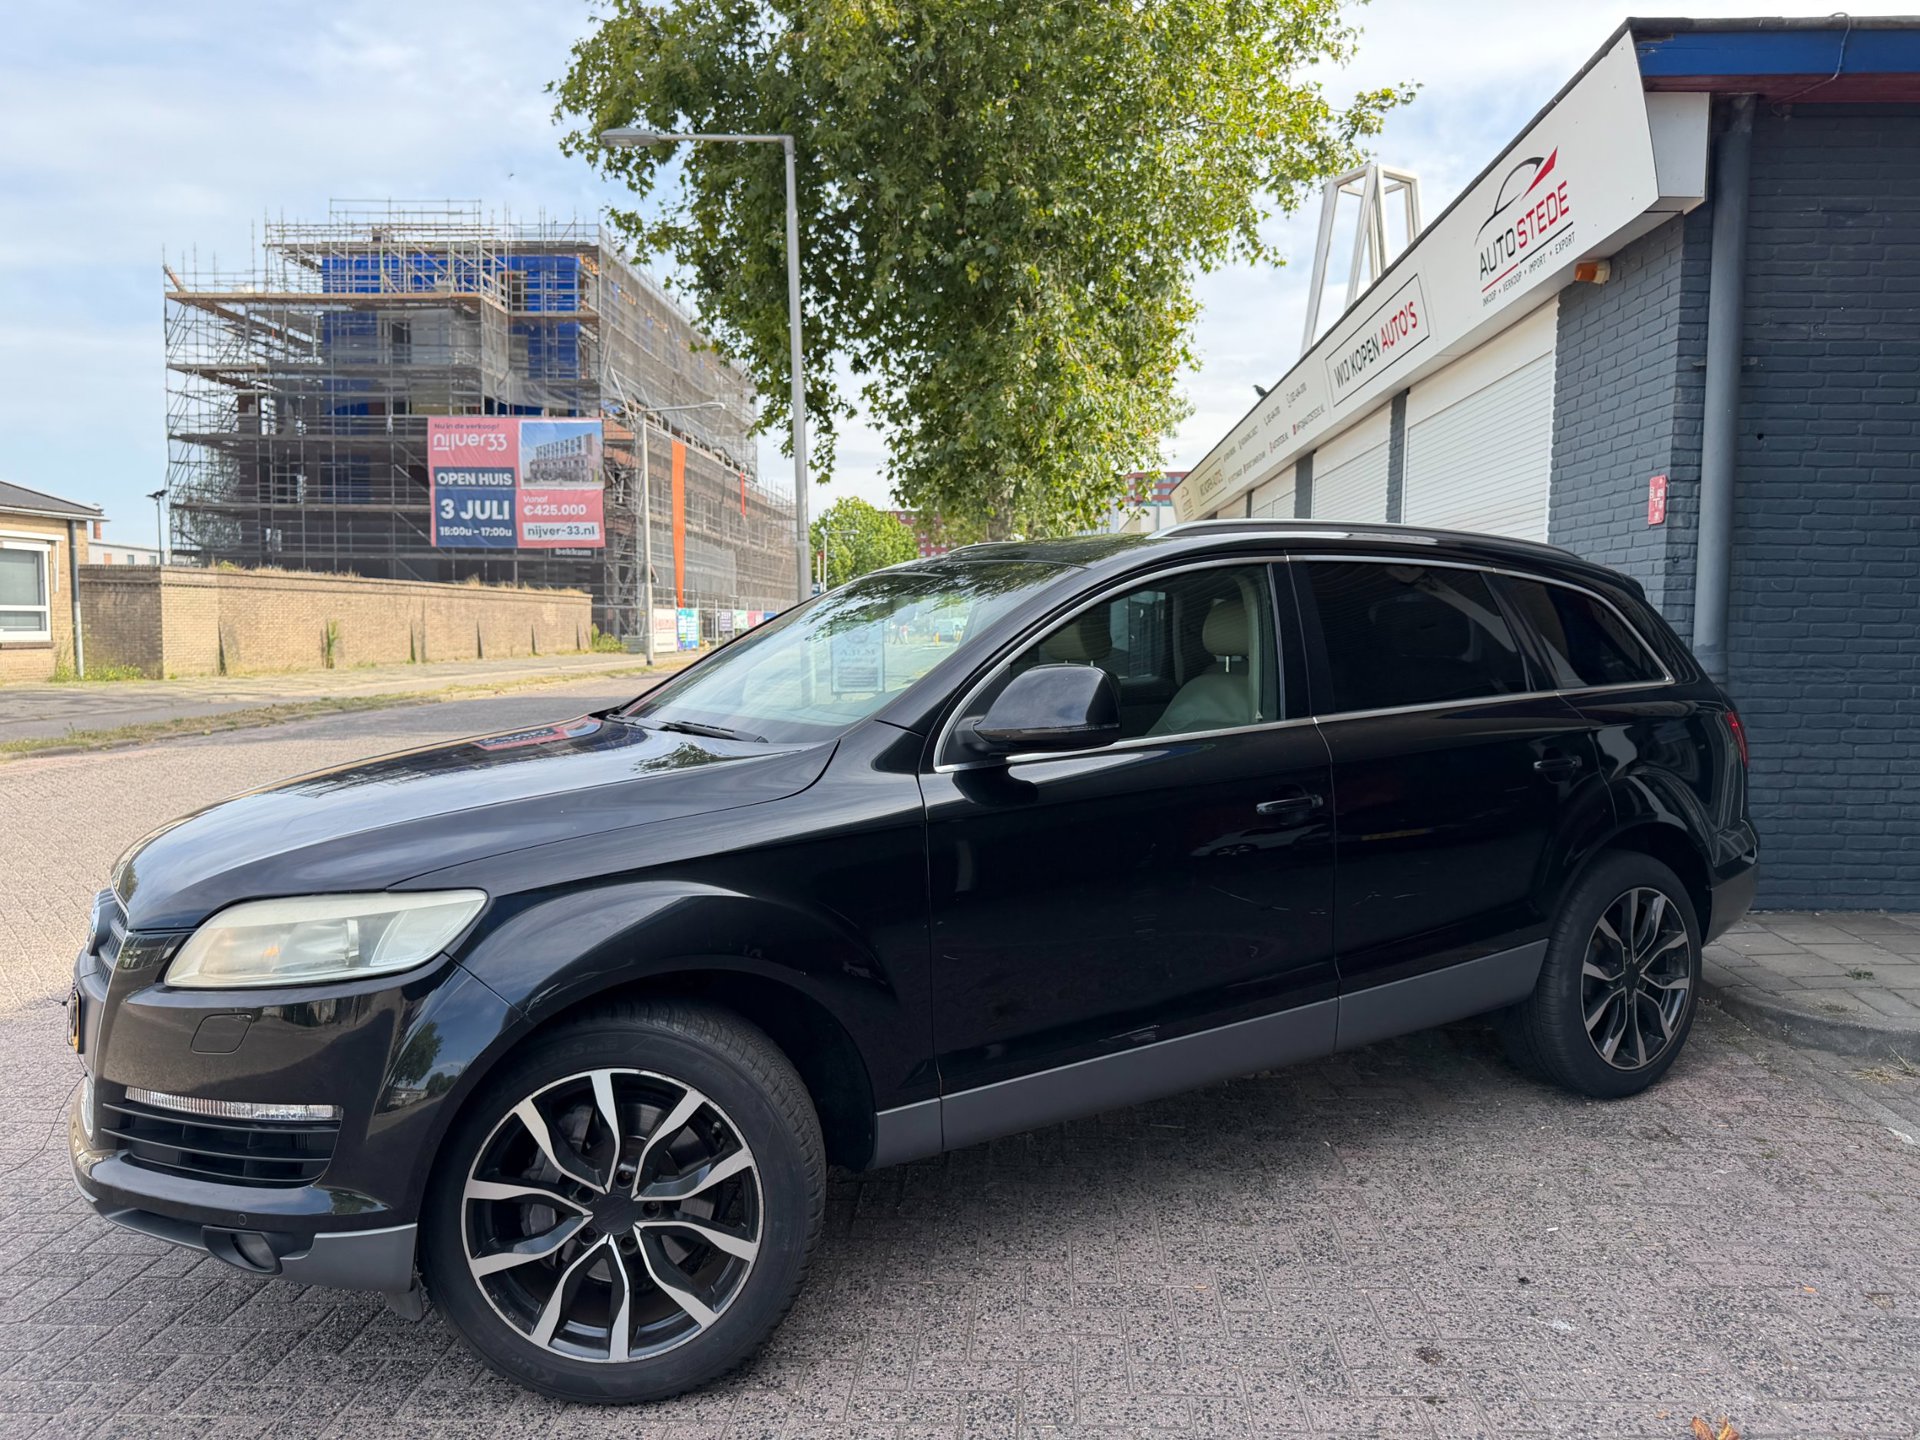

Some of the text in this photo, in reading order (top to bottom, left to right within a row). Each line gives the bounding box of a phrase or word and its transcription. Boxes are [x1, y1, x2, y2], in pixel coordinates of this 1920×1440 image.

[1480, 180, 1570, 281] AUTOSTEDE
[1482, 231, 1575, 307] INKOOP VERKOOP IMPORT EXPORT
[1334, 301, 1418, 388] WIJ KOPEN AUTO'S
[437, 472, 513, 486] OPEN HUIS
[441, 498, 510, 520] 3 JULI
[523, 504, 587, 516] €425.000
[480, 527, 513, 537] 17:00u
[528, 525, 596, 538] nijver-33.nl
